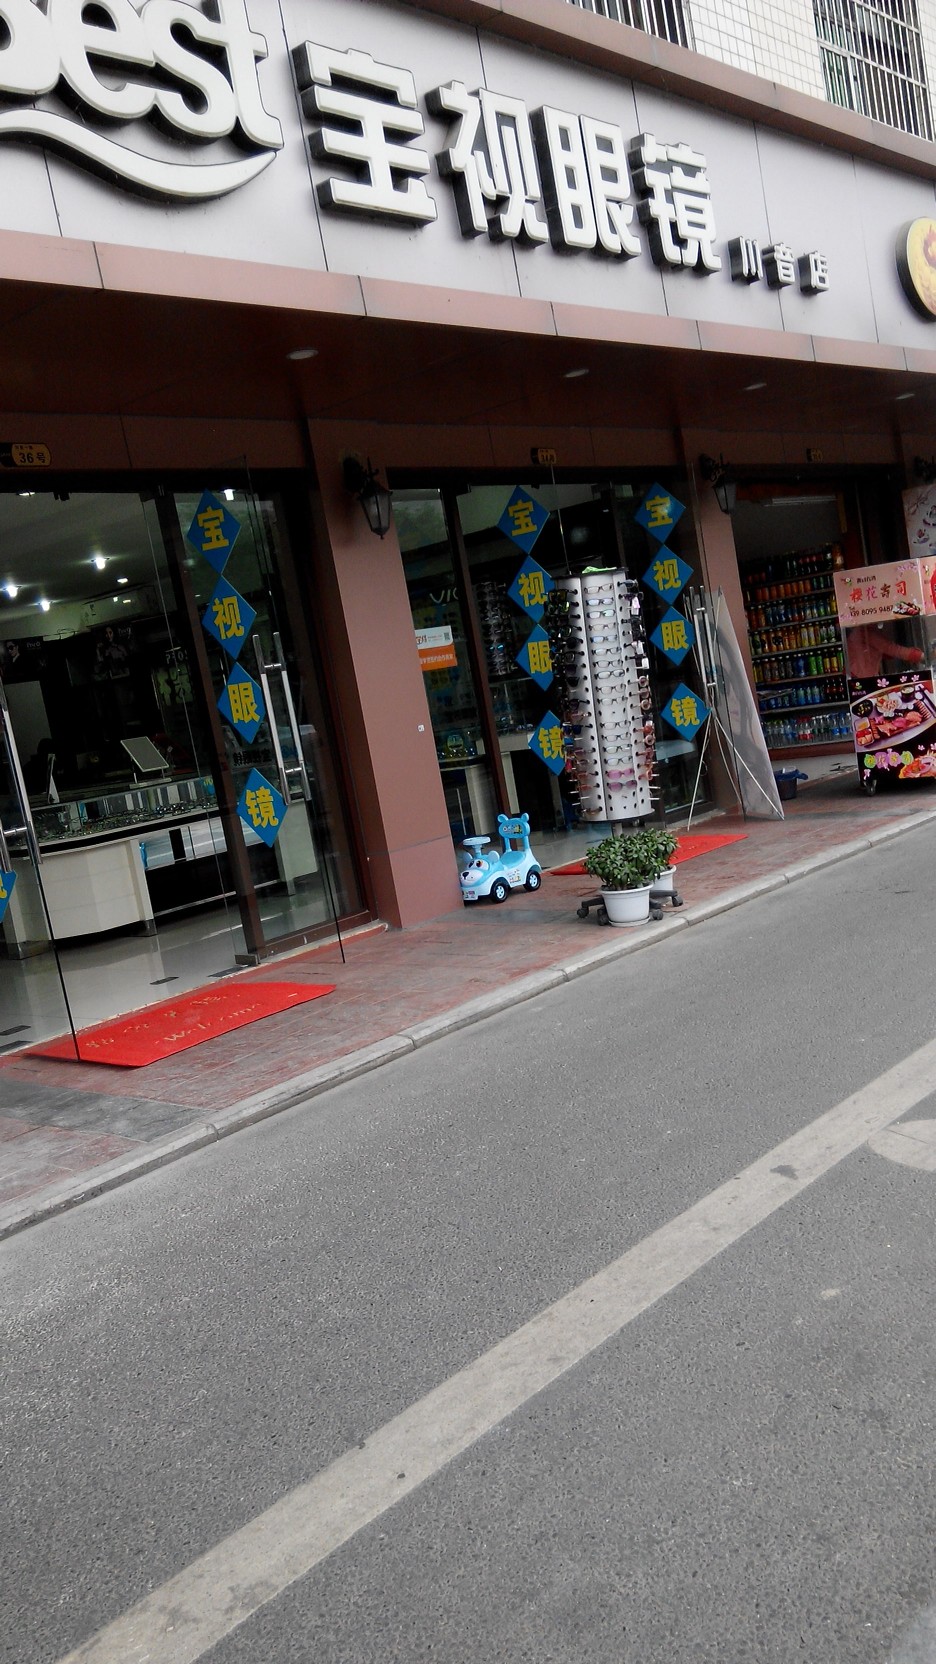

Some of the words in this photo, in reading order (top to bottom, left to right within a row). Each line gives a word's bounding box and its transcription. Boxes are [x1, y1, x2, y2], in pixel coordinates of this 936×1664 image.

[304, 41, 722, 272] 宝视眼镜
[738, 236, 830, 290] 川音店
[198, 506, 279, 828] 宝视眼镜
[508, 500, 566, 760] 宝视眼镜
[645, 495, 700, 727] 宝视眼镜
[861, 608, 878, 616] 8095
